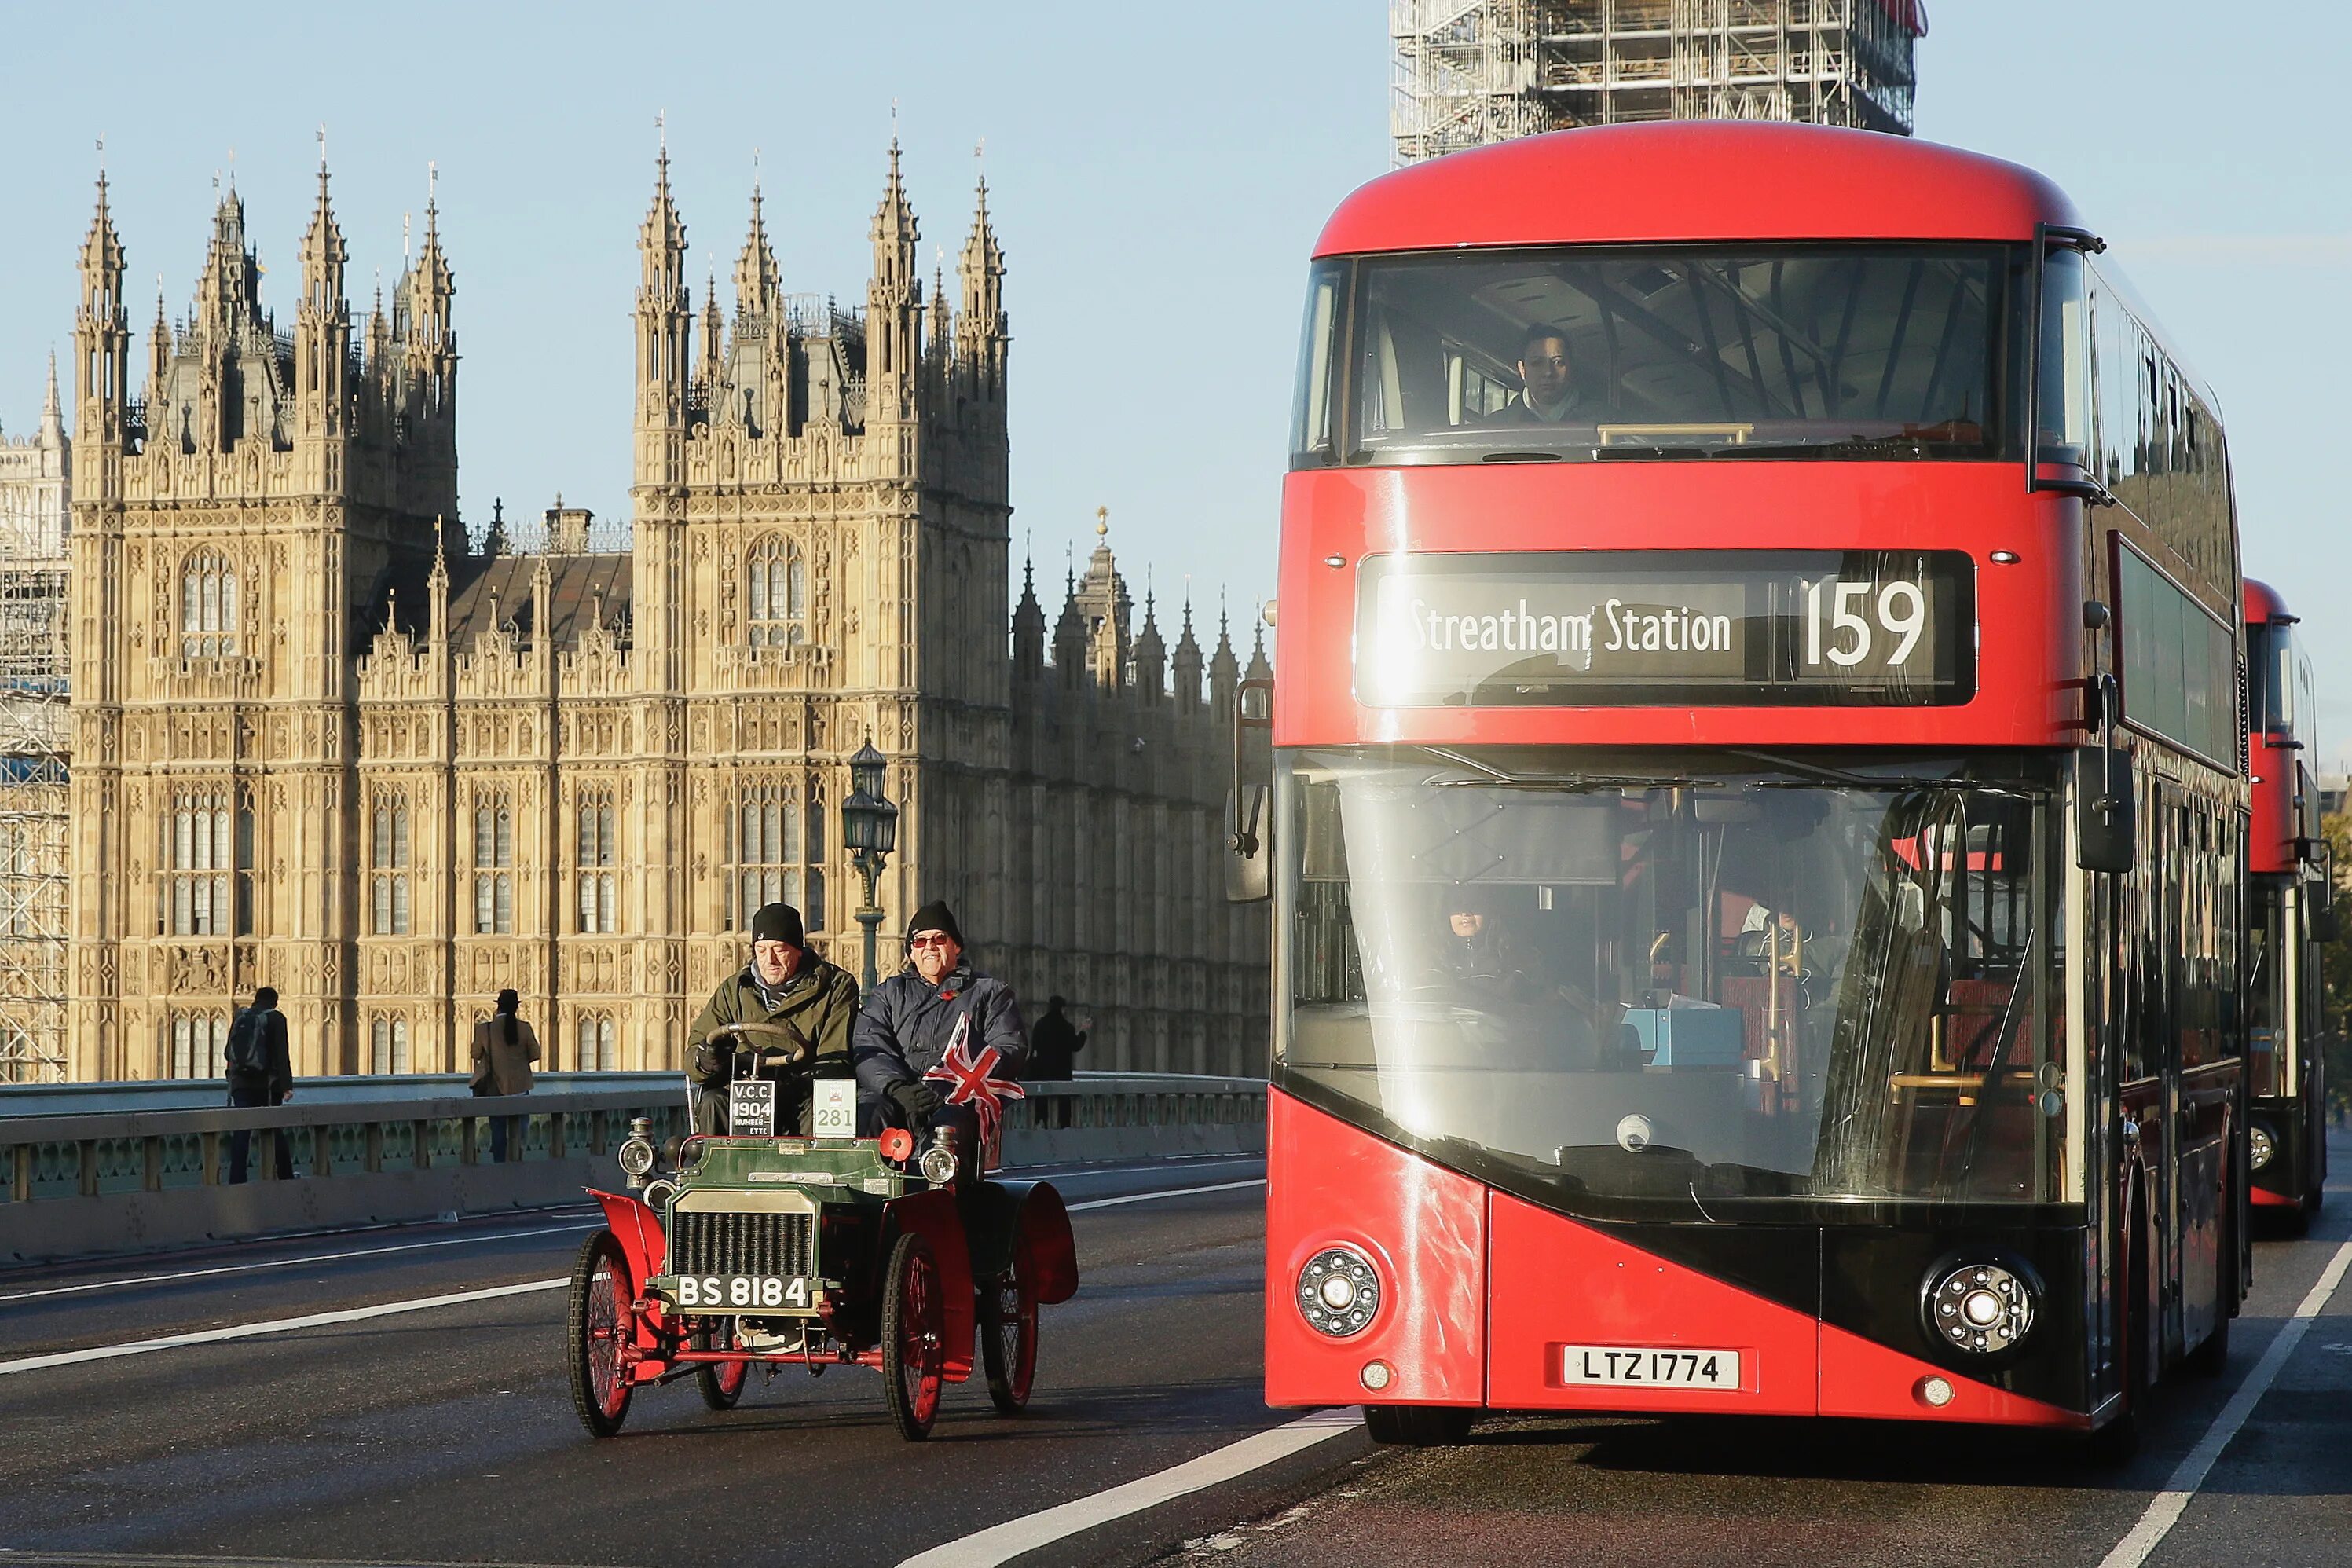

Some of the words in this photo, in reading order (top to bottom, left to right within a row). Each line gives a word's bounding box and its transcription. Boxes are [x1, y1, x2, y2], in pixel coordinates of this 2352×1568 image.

[1410, 599, 1590, 651] Streatham
[1605, 598, 1731, 651] Station
[1808, 581, 1925, 666] 159
[735, 1086, 771, 1099] V.C.C.
[733, 1102, 771, 1117] 1904
[818, 1109, 852, 1127] 281
[679, 1277, 723, 1306] BS
[730, 1277, 807, 1306] 8184
[1584, 1351, 1642, 1379] LTZ
[1652, 1353, 1719, 1383] 1774
